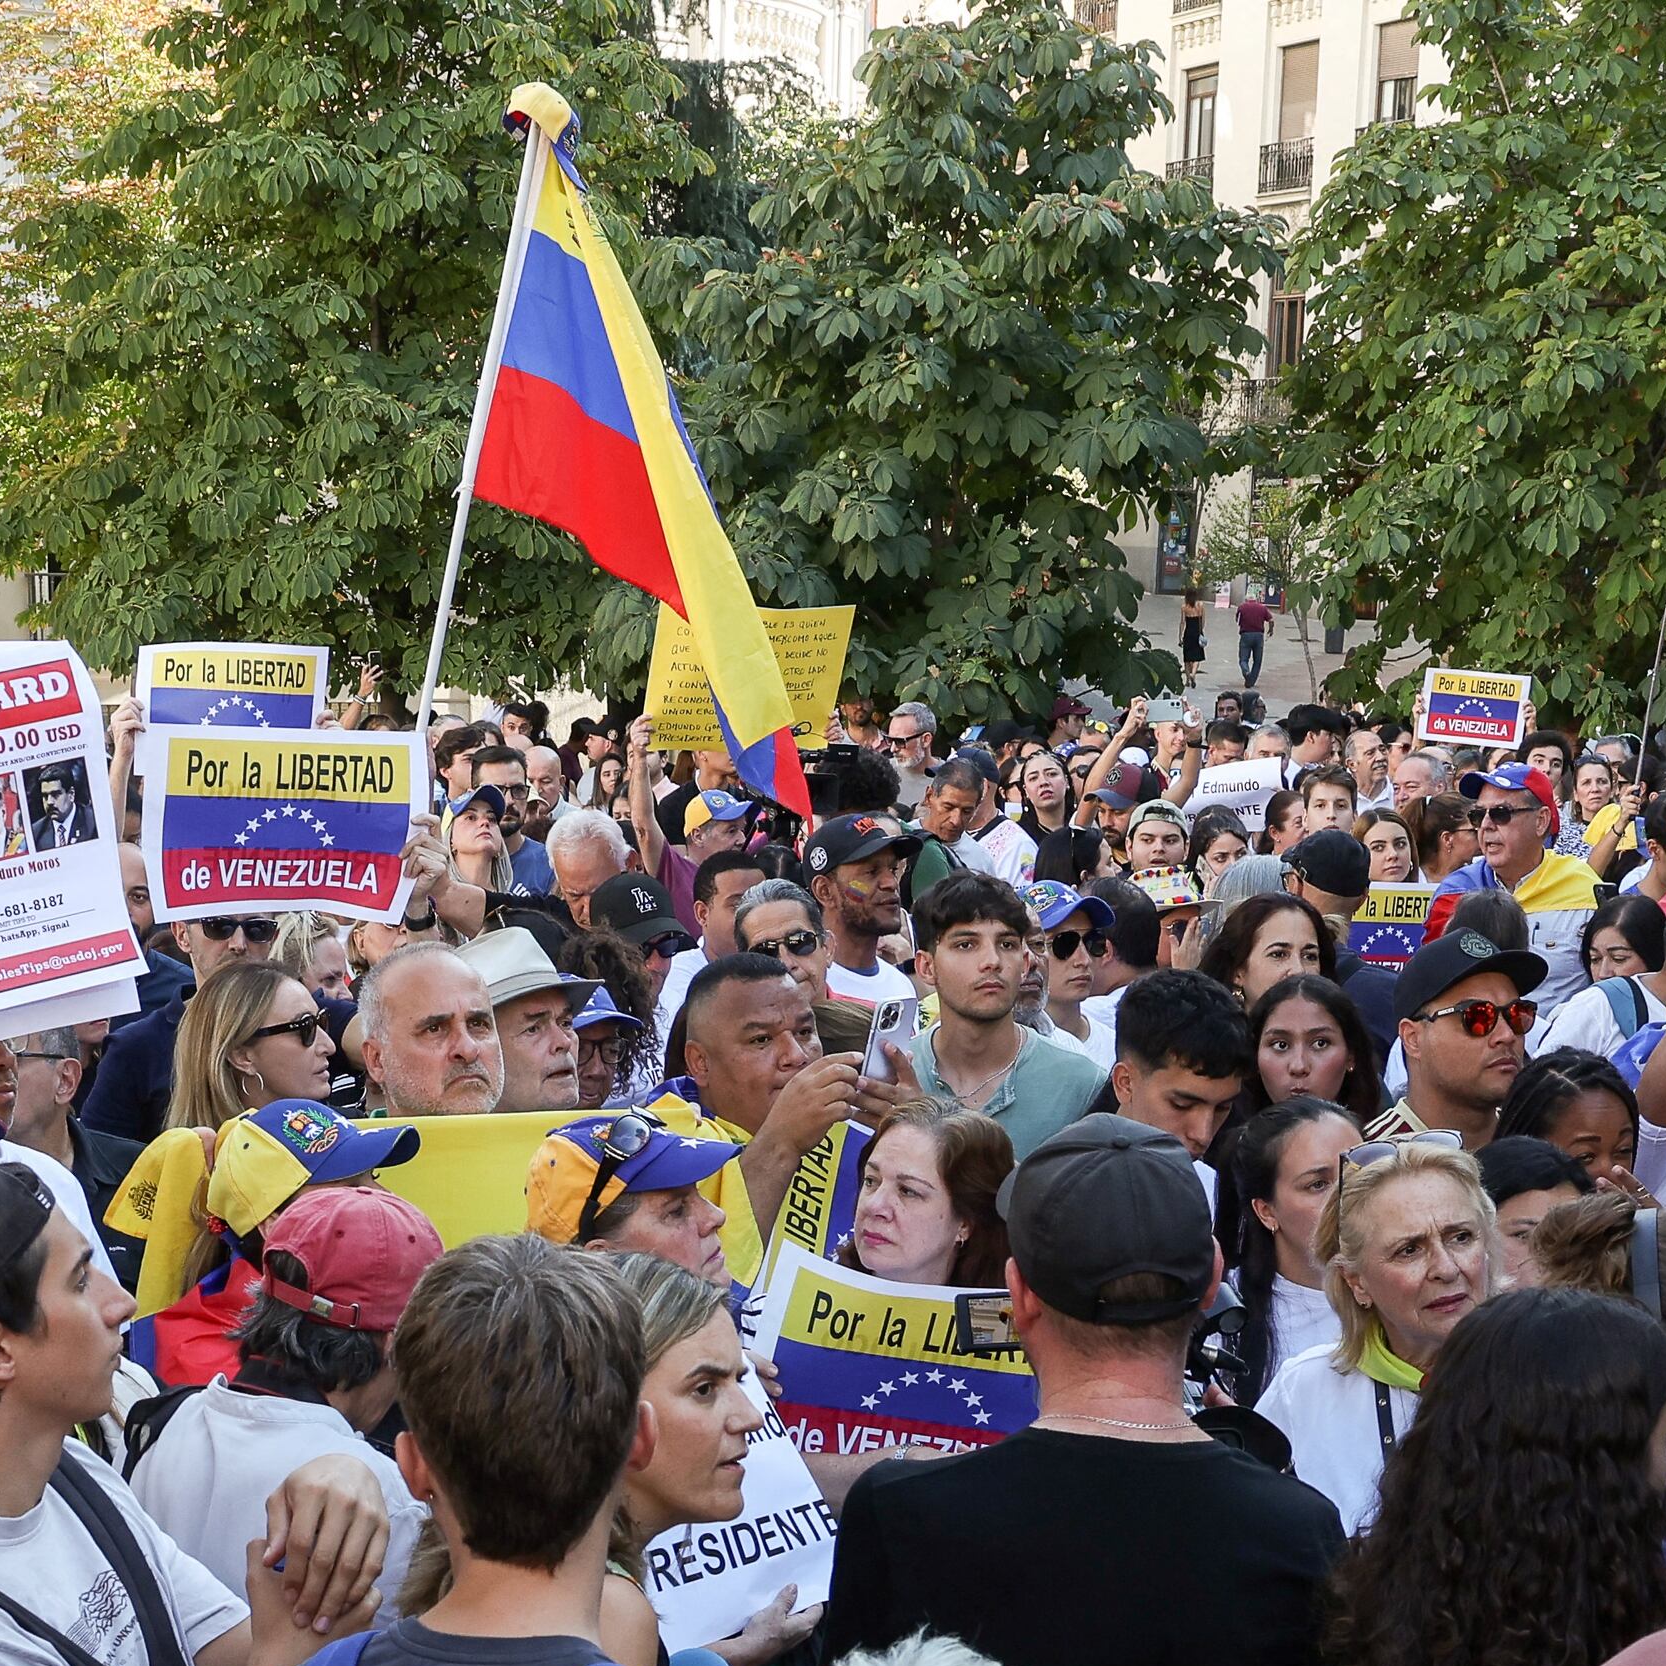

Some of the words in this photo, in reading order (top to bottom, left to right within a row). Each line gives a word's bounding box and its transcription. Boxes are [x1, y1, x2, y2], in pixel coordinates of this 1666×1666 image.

[165, 658, 192, 681] Por
[202, 658, 216, 682] la
[226, 659, 306, 688] LIBERTAD
[1438, 677, 1455, 691] Por
[1458, 679, 1465, 692] la
[1470, 680, 1516, 697] LIBERTAD
[45, 723, 81, 743] USD
[1433, 718, 1446, 730] de
[1448, 718, 1508, 736] VENEZUELA
[10, 756, 35, 766] AND/OR
[36, 745, 77, 760] CONVICTION
[187, 750, 229, 787] Por
[242, 752, 261, 789] la
[276, 753, 394, 793] LIBERTAD
[1202, 780, 1260, 794] Edmundo
[29, 857, 61, 874] Moros
[181, 860, 211, 890] de
[219, 859, 379, 894] VENEZUELA
[1366, 896, 1377, 917] la
[1383, 896, 1430, 918] LIBERT
[42, 920, 70, 934] Signal
[784, 1135, 834, 1253] IBERTAD
[807, 1290, 865, 1341] Por
[879, 1307, 907, 1348] la
[788, 1417, 825, 1454] de
[648, 1498, 838, 1592] RESIDENTE
